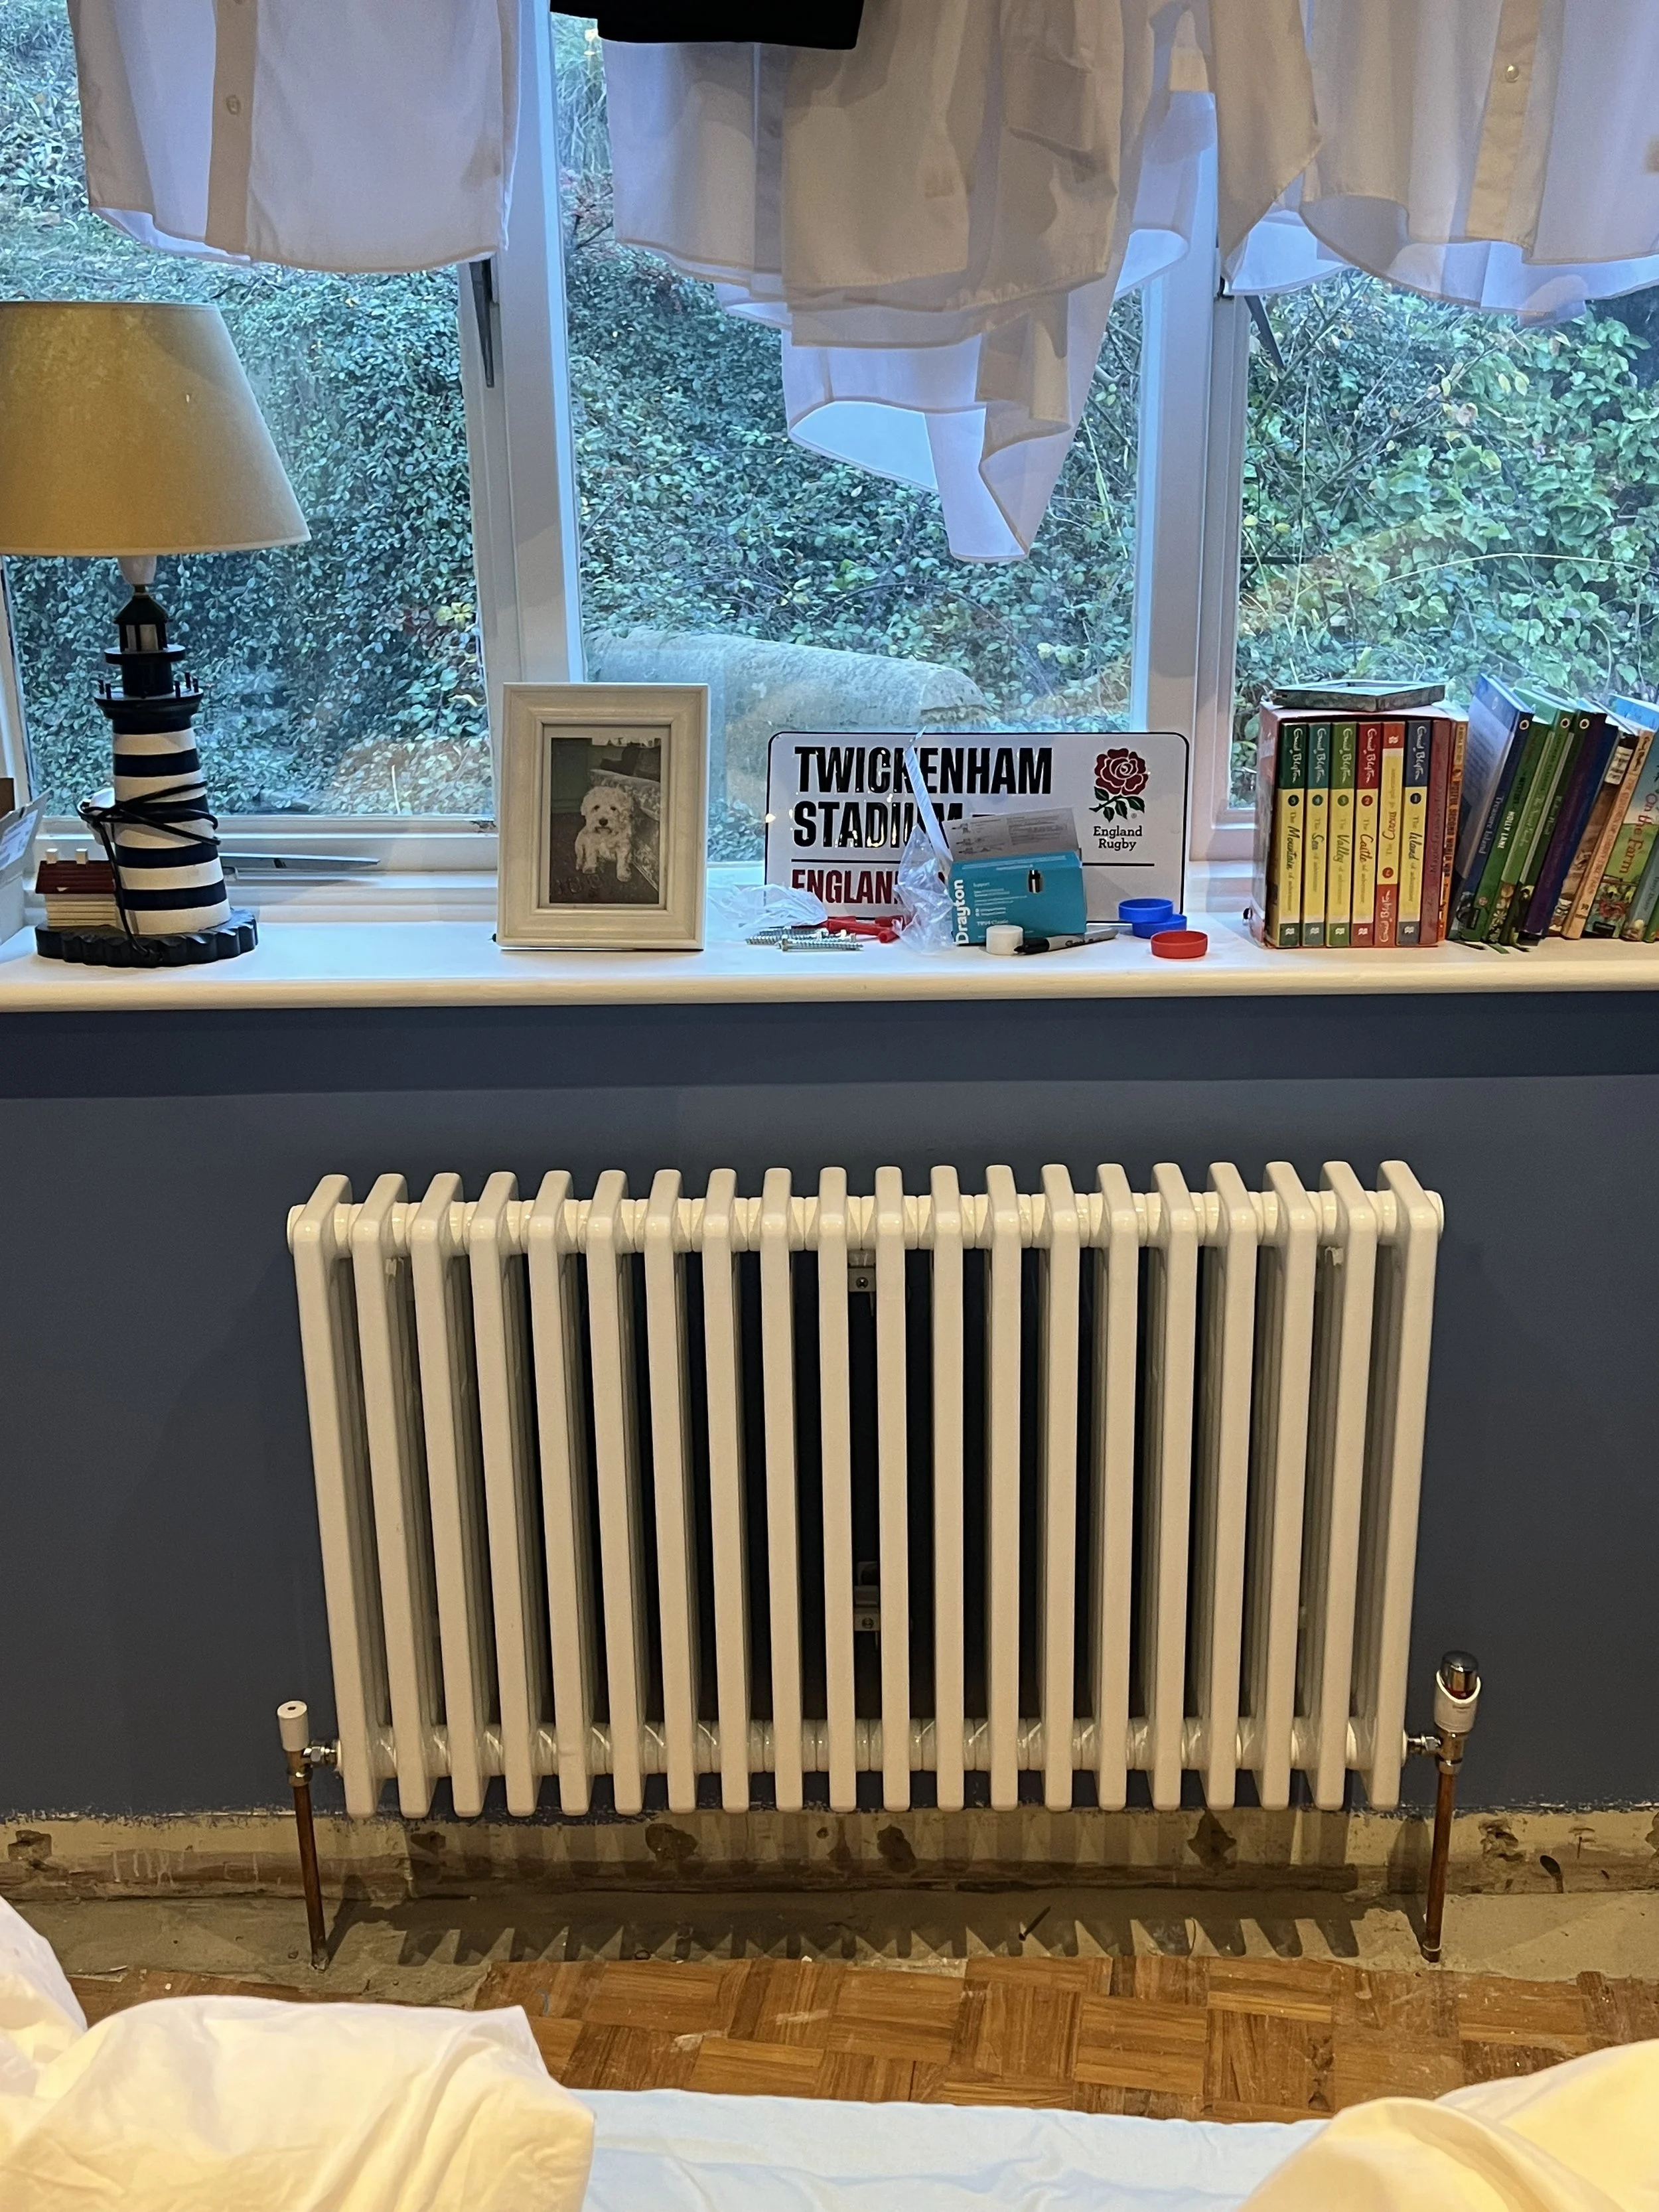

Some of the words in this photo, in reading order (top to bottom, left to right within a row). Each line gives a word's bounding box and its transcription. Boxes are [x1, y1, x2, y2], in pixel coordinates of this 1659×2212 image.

[794, 747, 1052, 794] TWICKENHAM
[1291, 753, 1302, 783] Blyton
[1314, 753, 1326, 783] Blyton
[1340, 753, 1352, 784] Blyton
[1364, 753, 1376, 783] Blyton
[1413, 751, 1425, 780] Blyton
[1486, 796, 1505, 830] Treasure
[1644, 793, 1658, 812] On
[1093, 825, 1142, 839] England
[1382, 811, 1397, 841] Circus
[1411, 816, 1419, 829] The
[1447, 806, 1458, 835] SECOND
[1504, 811, 1516, 832] HOLLY
[1634, 814, 1654, 834] the
[1098, 838, 1137, 851] Rugby
[1286, 826, 1300, 870] Mountain
[1311, 832, 1325, 850] Sea
[1333, 834, 1350, 863] Valley
[1360, 834, 1374, 863] Castle
[1408, 832, 1423, 861] Island
[1479, 830, 1493, 854] Island
[1496, 832, 1509, 849] LANE
[1619, 838, 1644, 873] Farm
[792, 869, 903, 904] ENGLAN
[954, 879, 971, 944] Drayton
[1380, 890, 1392, 919] Blyton
